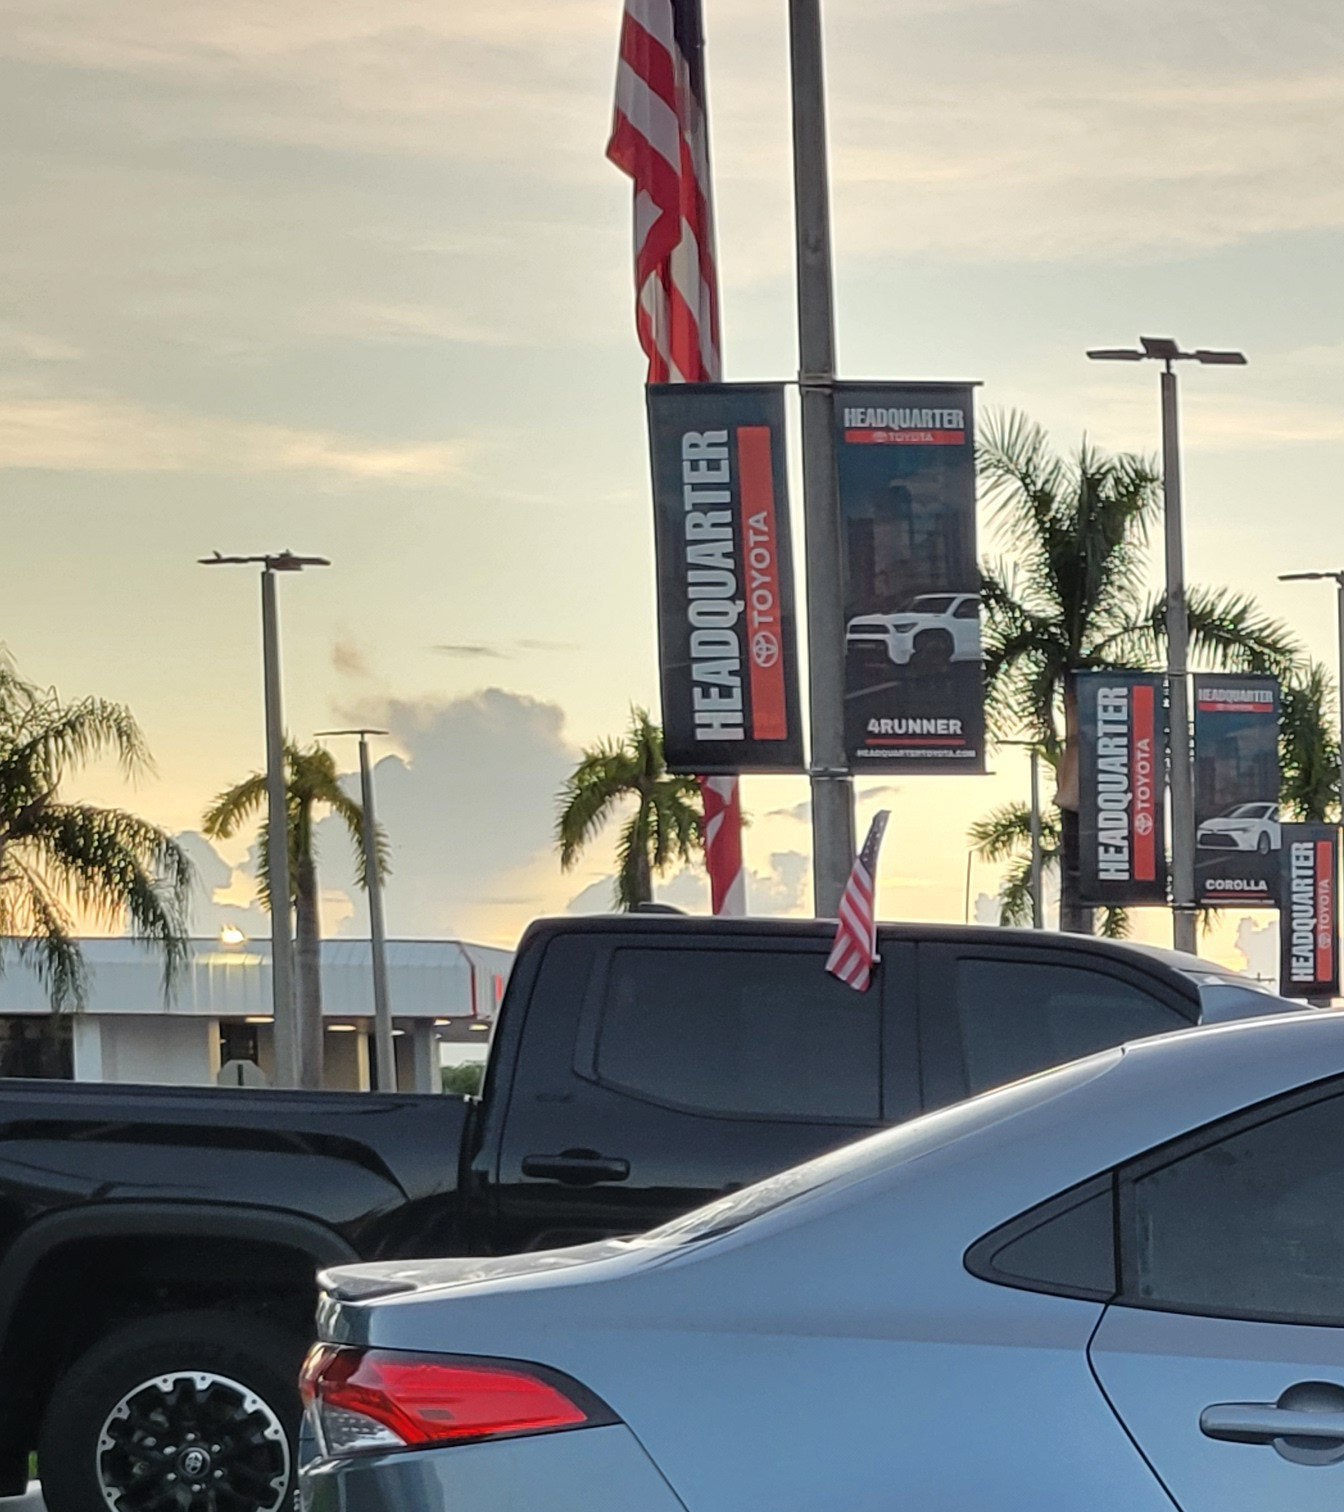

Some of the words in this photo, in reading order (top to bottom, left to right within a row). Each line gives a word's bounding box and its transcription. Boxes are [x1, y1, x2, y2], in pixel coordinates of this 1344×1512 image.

[844, 408, 965, 430] HEADQUARTER
[889, 432, 934, 442] TOYOTA
[682, 429, 745, 741] HEADQUARTER
[748, 511, 774, 628] TOYOTA
[1198, 688, 1274, 703] HEADQUARTER
[867, 718, 962, 735] 4RUNNER
[1098, 686, 1132, 881] HEADQUARTER
[1136, 738, 1151, 810] TOYOTA
[1205, 878, 1268, 891] COROLLA
[1318, 878, 1330, 930] TOYOTA
[1291, 842, 1317, 982] HEADQUARTER
